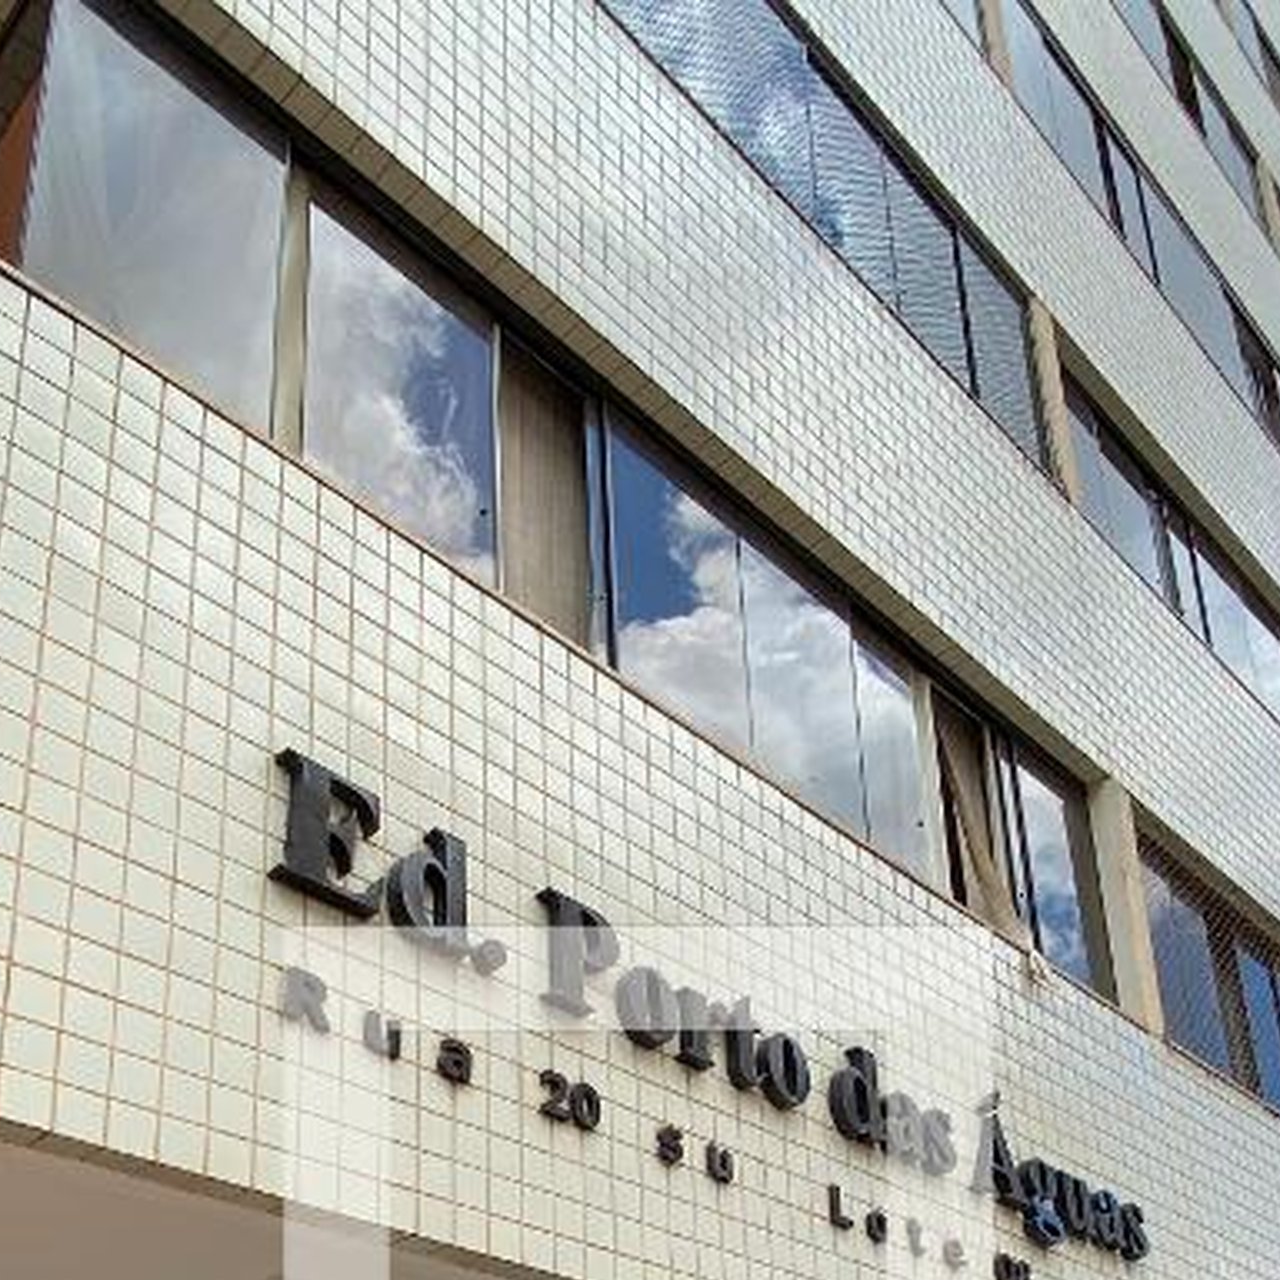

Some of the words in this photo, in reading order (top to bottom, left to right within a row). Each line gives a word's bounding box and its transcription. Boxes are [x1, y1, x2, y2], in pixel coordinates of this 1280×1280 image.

[267, 746, 507, 976] Ed.
[535, 885, 810, 1111] Porto
[827, 1046, 957, 1177] das
[970, 1089, 1150, 1261] Águas
[282, 965, 472, 1085] Rua
[538, 1069, 601, 1131] 20
